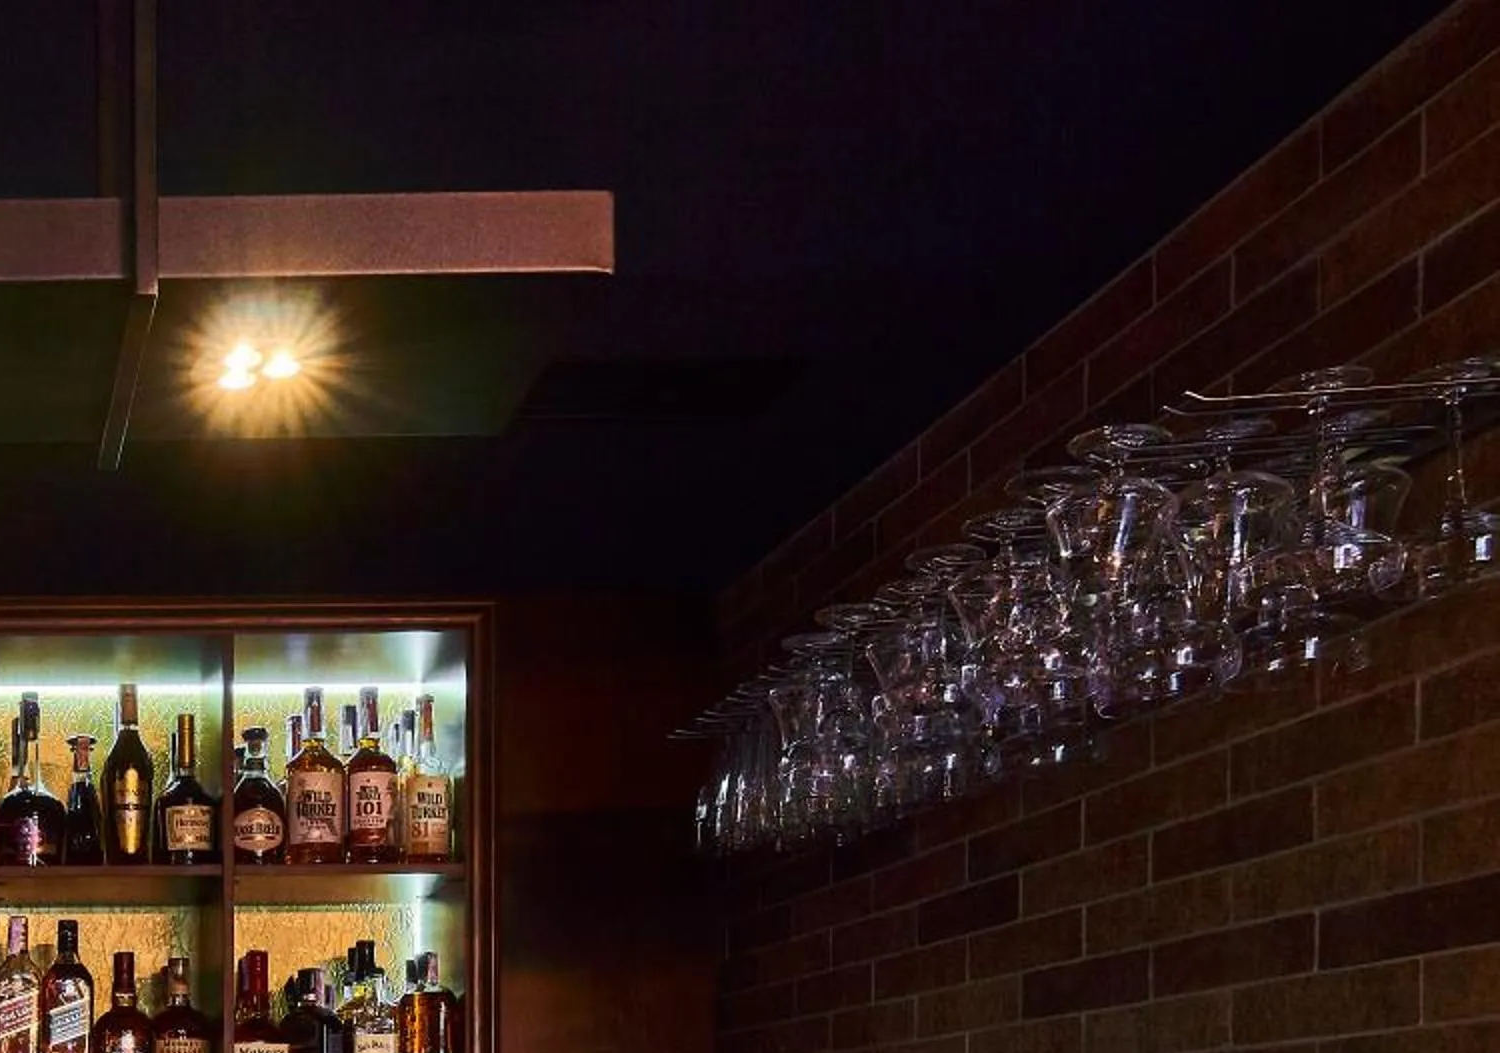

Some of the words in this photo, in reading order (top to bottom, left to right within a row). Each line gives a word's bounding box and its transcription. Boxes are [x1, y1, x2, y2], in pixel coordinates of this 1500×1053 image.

[303, 790, 332, 802] WILD
[417, 792, 443, 804] WILD
[356, 802, 382, 817] 101
[412, 822, 429, 838] 81
